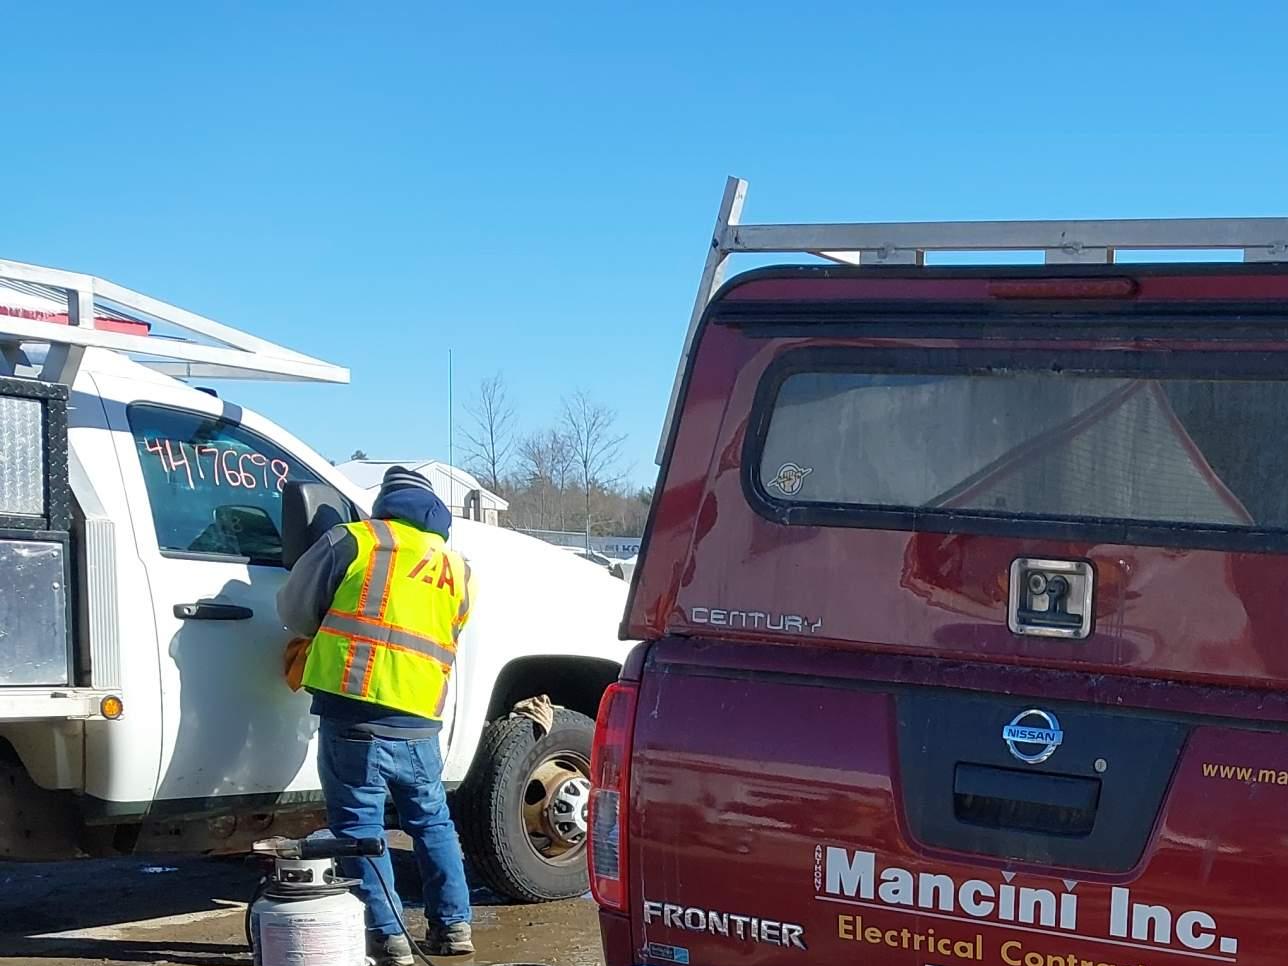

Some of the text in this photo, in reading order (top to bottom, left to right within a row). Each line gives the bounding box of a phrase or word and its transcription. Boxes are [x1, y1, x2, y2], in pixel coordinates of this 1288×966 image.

[692, 608, 823, 633] CENTURY
[1007, 728, 1056, 742] NISSAN
[814, 844, 822, 892] ANTHONY
[825, 846, 1238, 954] Mancini Inc.
[643, 900, 808, 951] FRONTIER
[838, 914, 983, 960] Electrical
